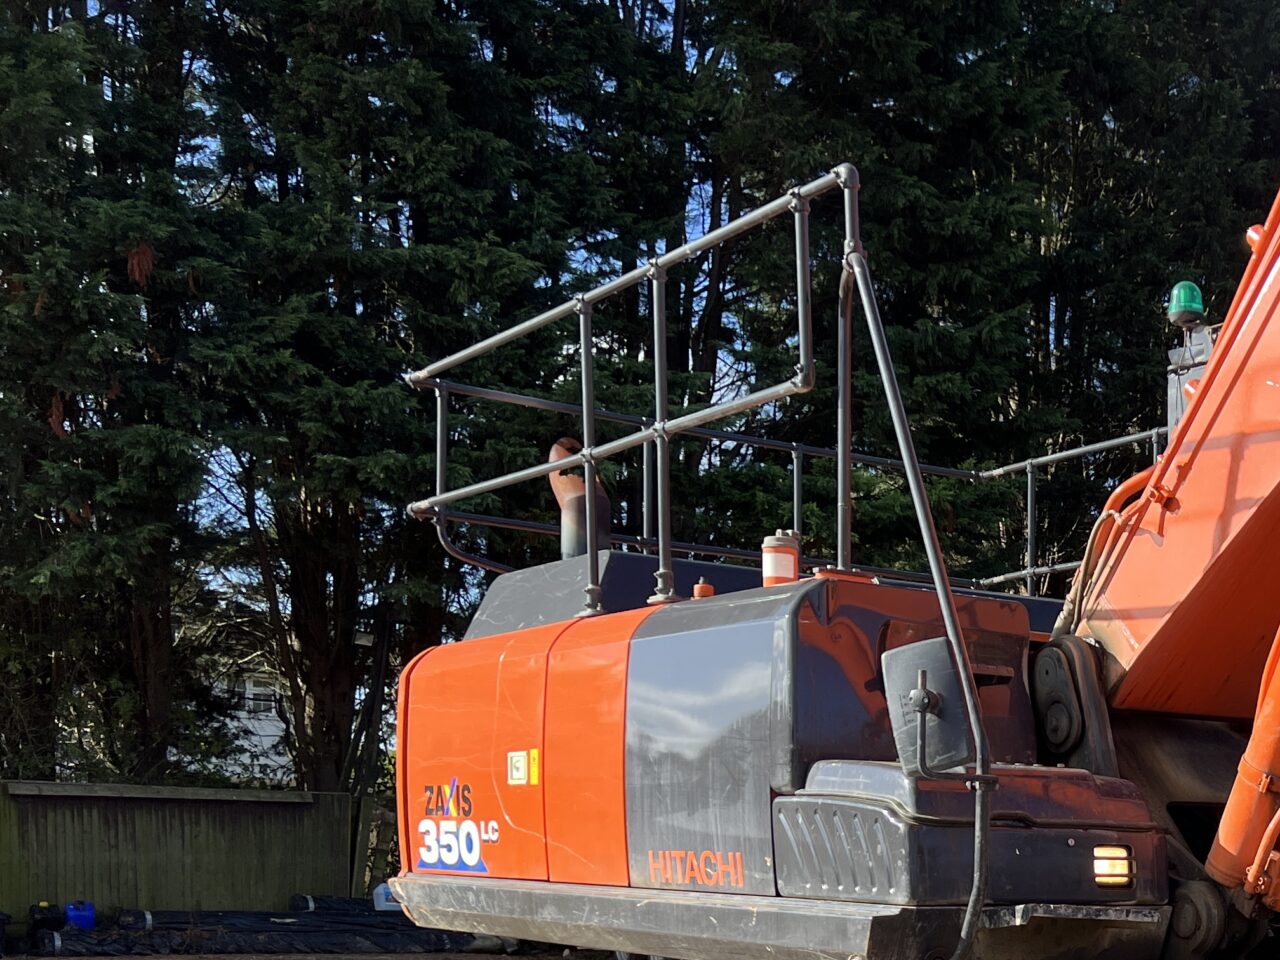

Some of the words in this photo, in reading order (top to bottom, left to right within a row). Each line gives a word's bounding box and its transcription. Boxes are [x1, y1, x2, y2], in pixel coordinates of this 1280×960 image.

[424, 777, 472, 817] ZAXIS
[418, 818, 480, 866] 350
[480, 820, 499, 842] LC
[648, 850, 744, 887] HITACHI
